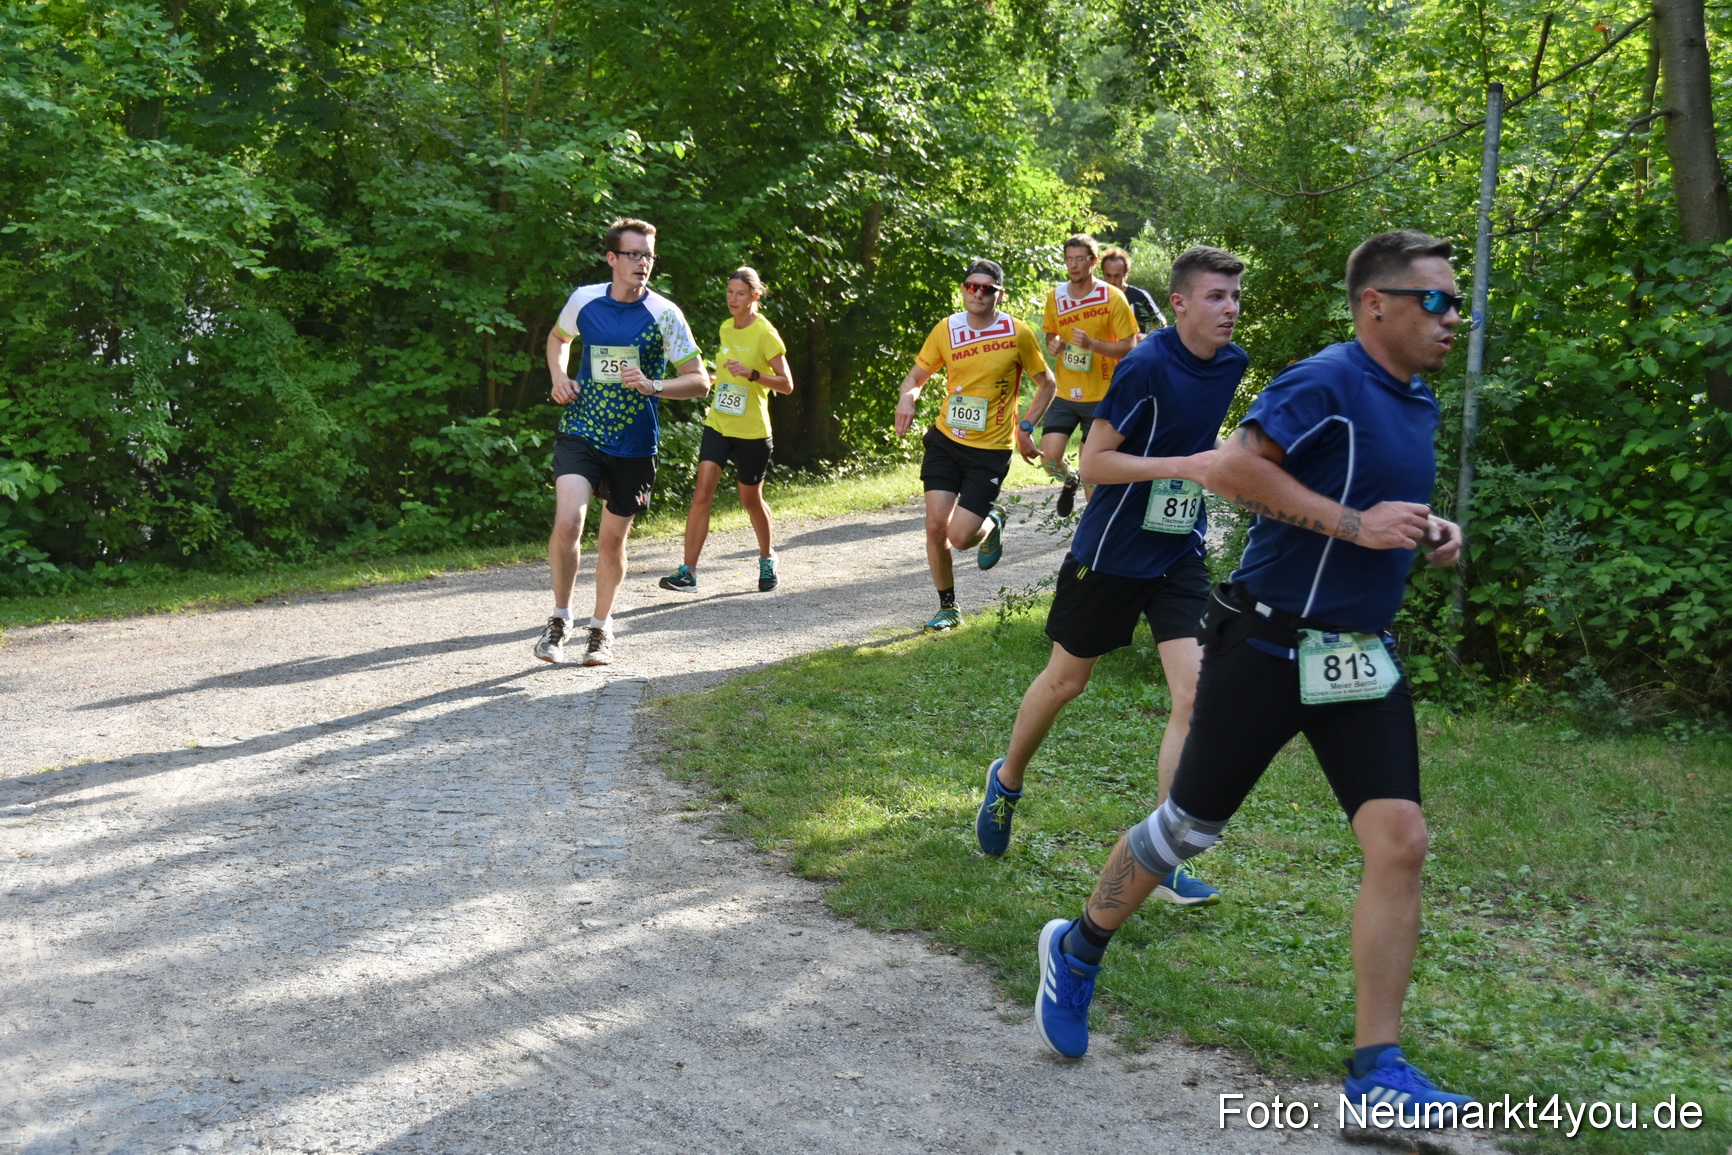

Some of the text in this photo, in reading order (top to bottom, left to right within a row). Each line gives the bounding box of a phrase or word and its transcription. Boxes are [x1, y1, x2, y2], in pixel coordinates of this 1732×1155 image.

[1059, 307, 1110, 327] MAX BÖGL
[952, 340, 1017, 361] MAX BÖGL
[1064, 352, 1086, 365] 1694
[718, 393, 741, 407] 1258
[952, 406, 980, 421] 1603
[1164, 497, 1197, 518] 818
[1324, 653, 1377, 681] 813
[1330, 679, 1377, 690] Meier Bernd
